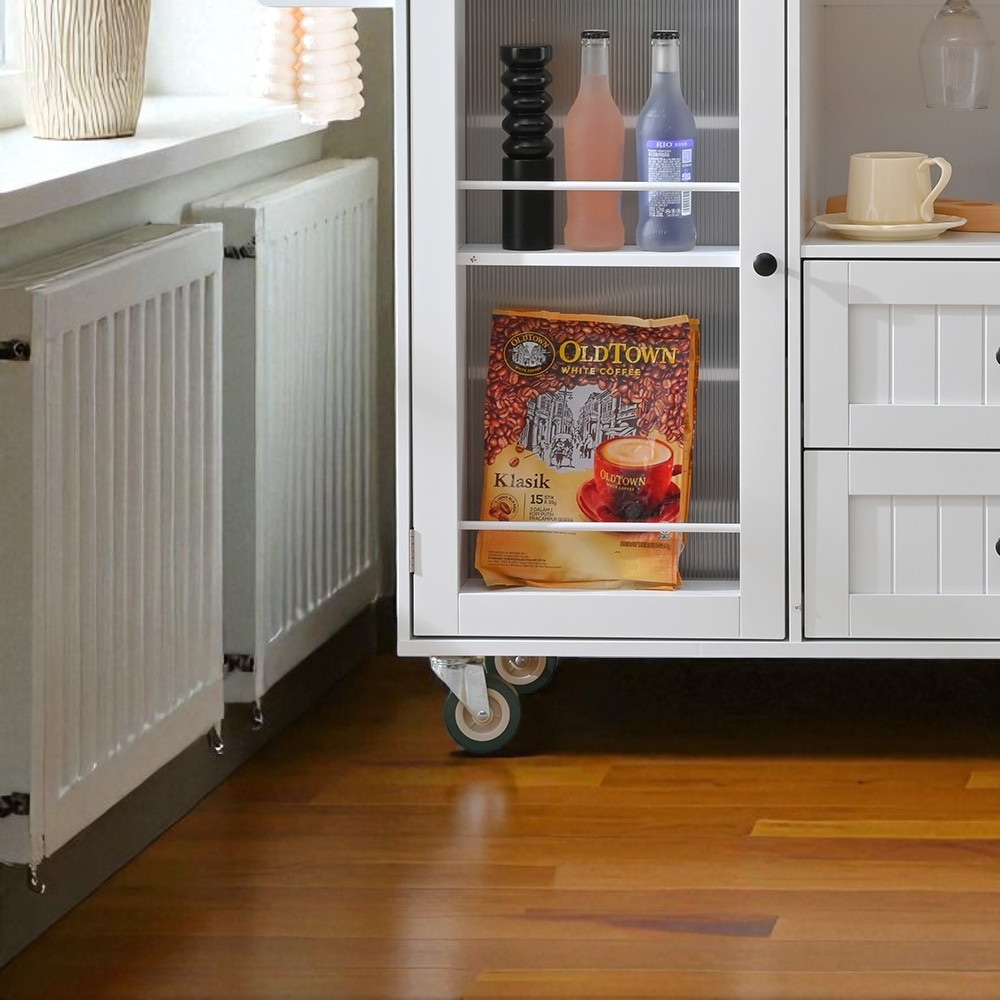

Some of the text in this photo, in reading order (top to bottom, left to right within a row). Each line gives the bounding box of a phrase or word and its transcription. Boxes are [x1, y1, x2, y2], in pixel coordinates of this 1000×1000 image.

[510, 333, 550, 349] OLDTOWN
[558, 339, 678, 364] OLDTOWN
[560, 366, 642, 377] WHITE COFFEE
[493, 472, 551, 489] Klasik
[600, 469, 647, 486] OLDTOWN
[530, 494, 544, 505] 15
